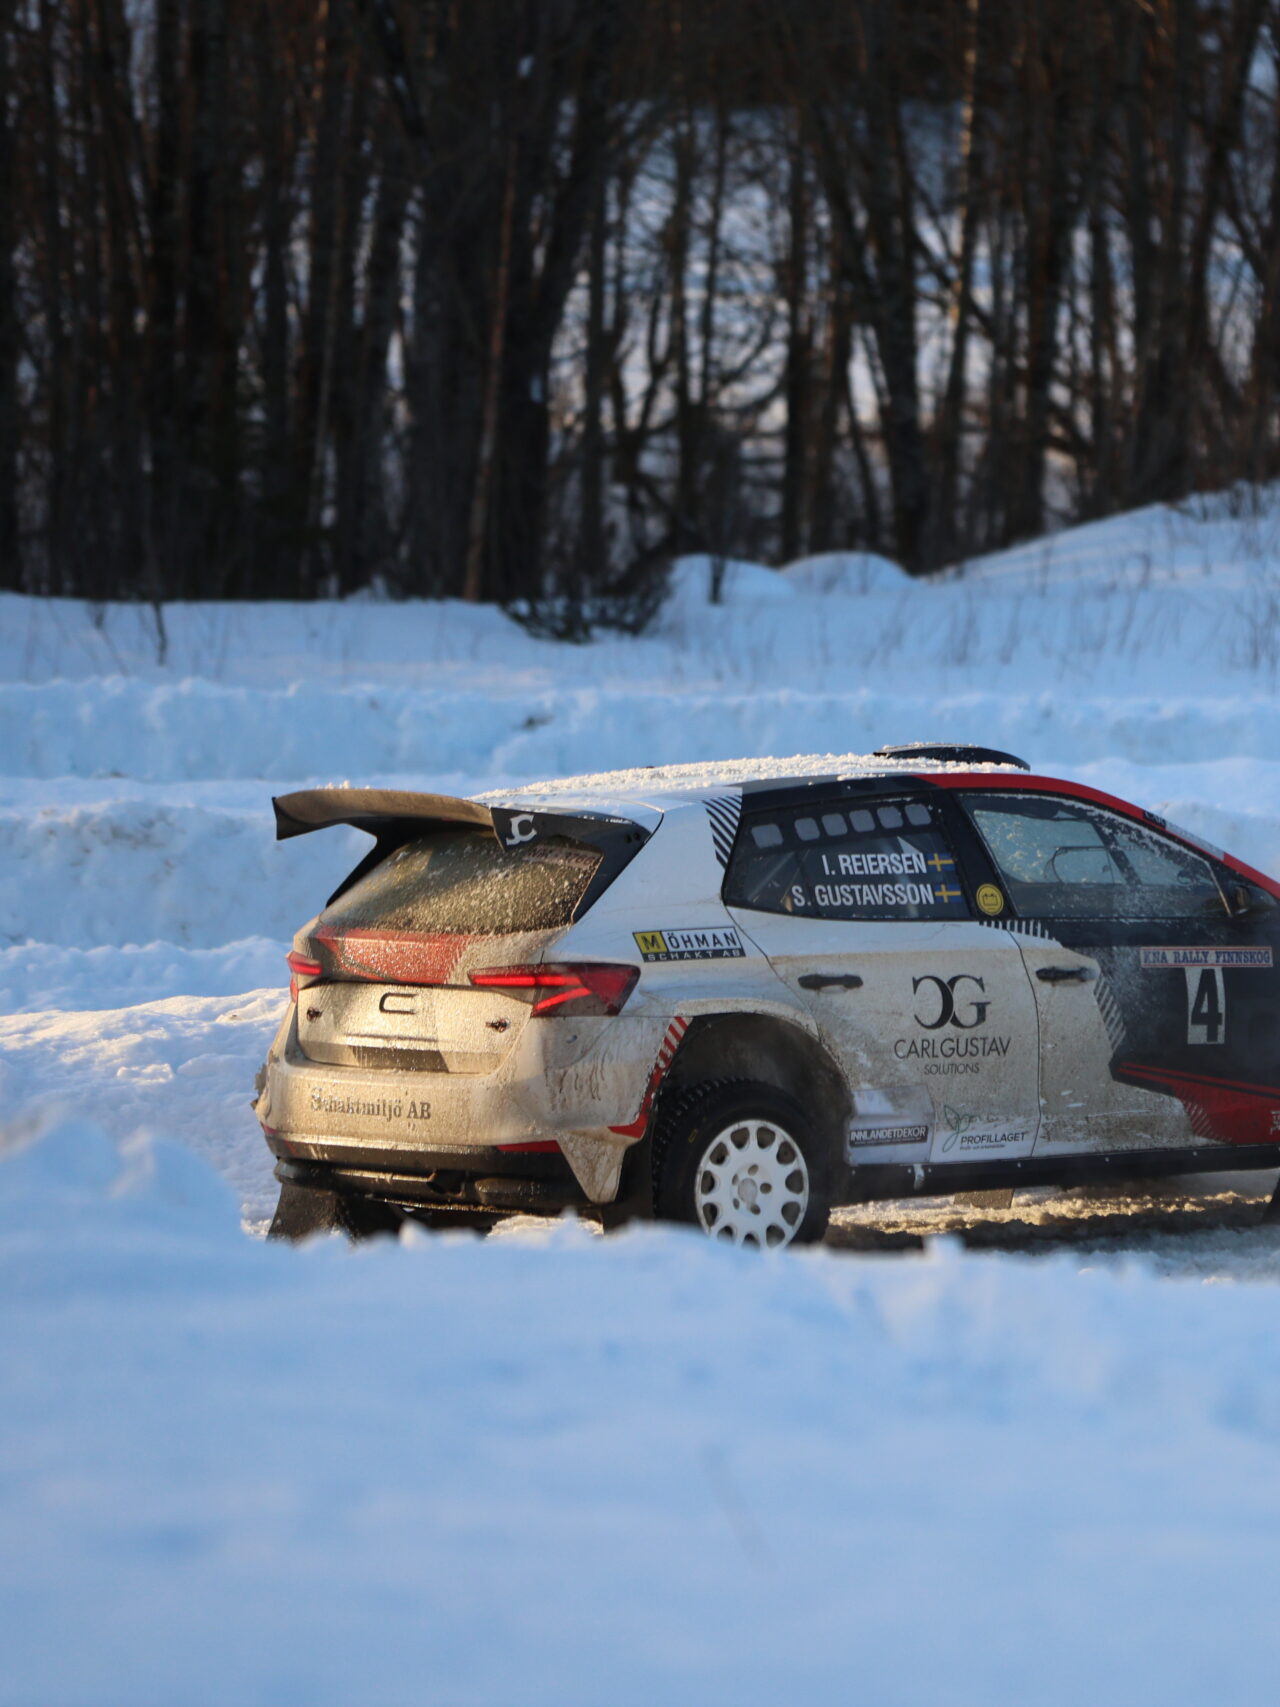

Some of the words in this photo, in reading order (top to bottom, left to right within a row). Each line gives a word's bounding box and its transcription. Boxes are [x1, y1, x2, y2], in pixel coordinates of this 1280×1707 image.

[821, 854, 836, 876] I.
[838, 852, 928, 876] REIERSEN
[791, 884, 812, 908] S.
[814, 883, 935, 907] GUSTAVSSON
[647, 951, 714, 962] SCHAKT
[722, 949, 741, 958] AB
[1174, 951, 1209, 964] RALLY
[1215, 950, 1271, 964] FINNSKOG
[1191, 968, 1223, 1042] 4
[924, 1062, 980, 1076] SOLUTIONS
[406, 1100, 432, 1120] AB
[960, 1131, 1026, 1145] PROFILLAGET
